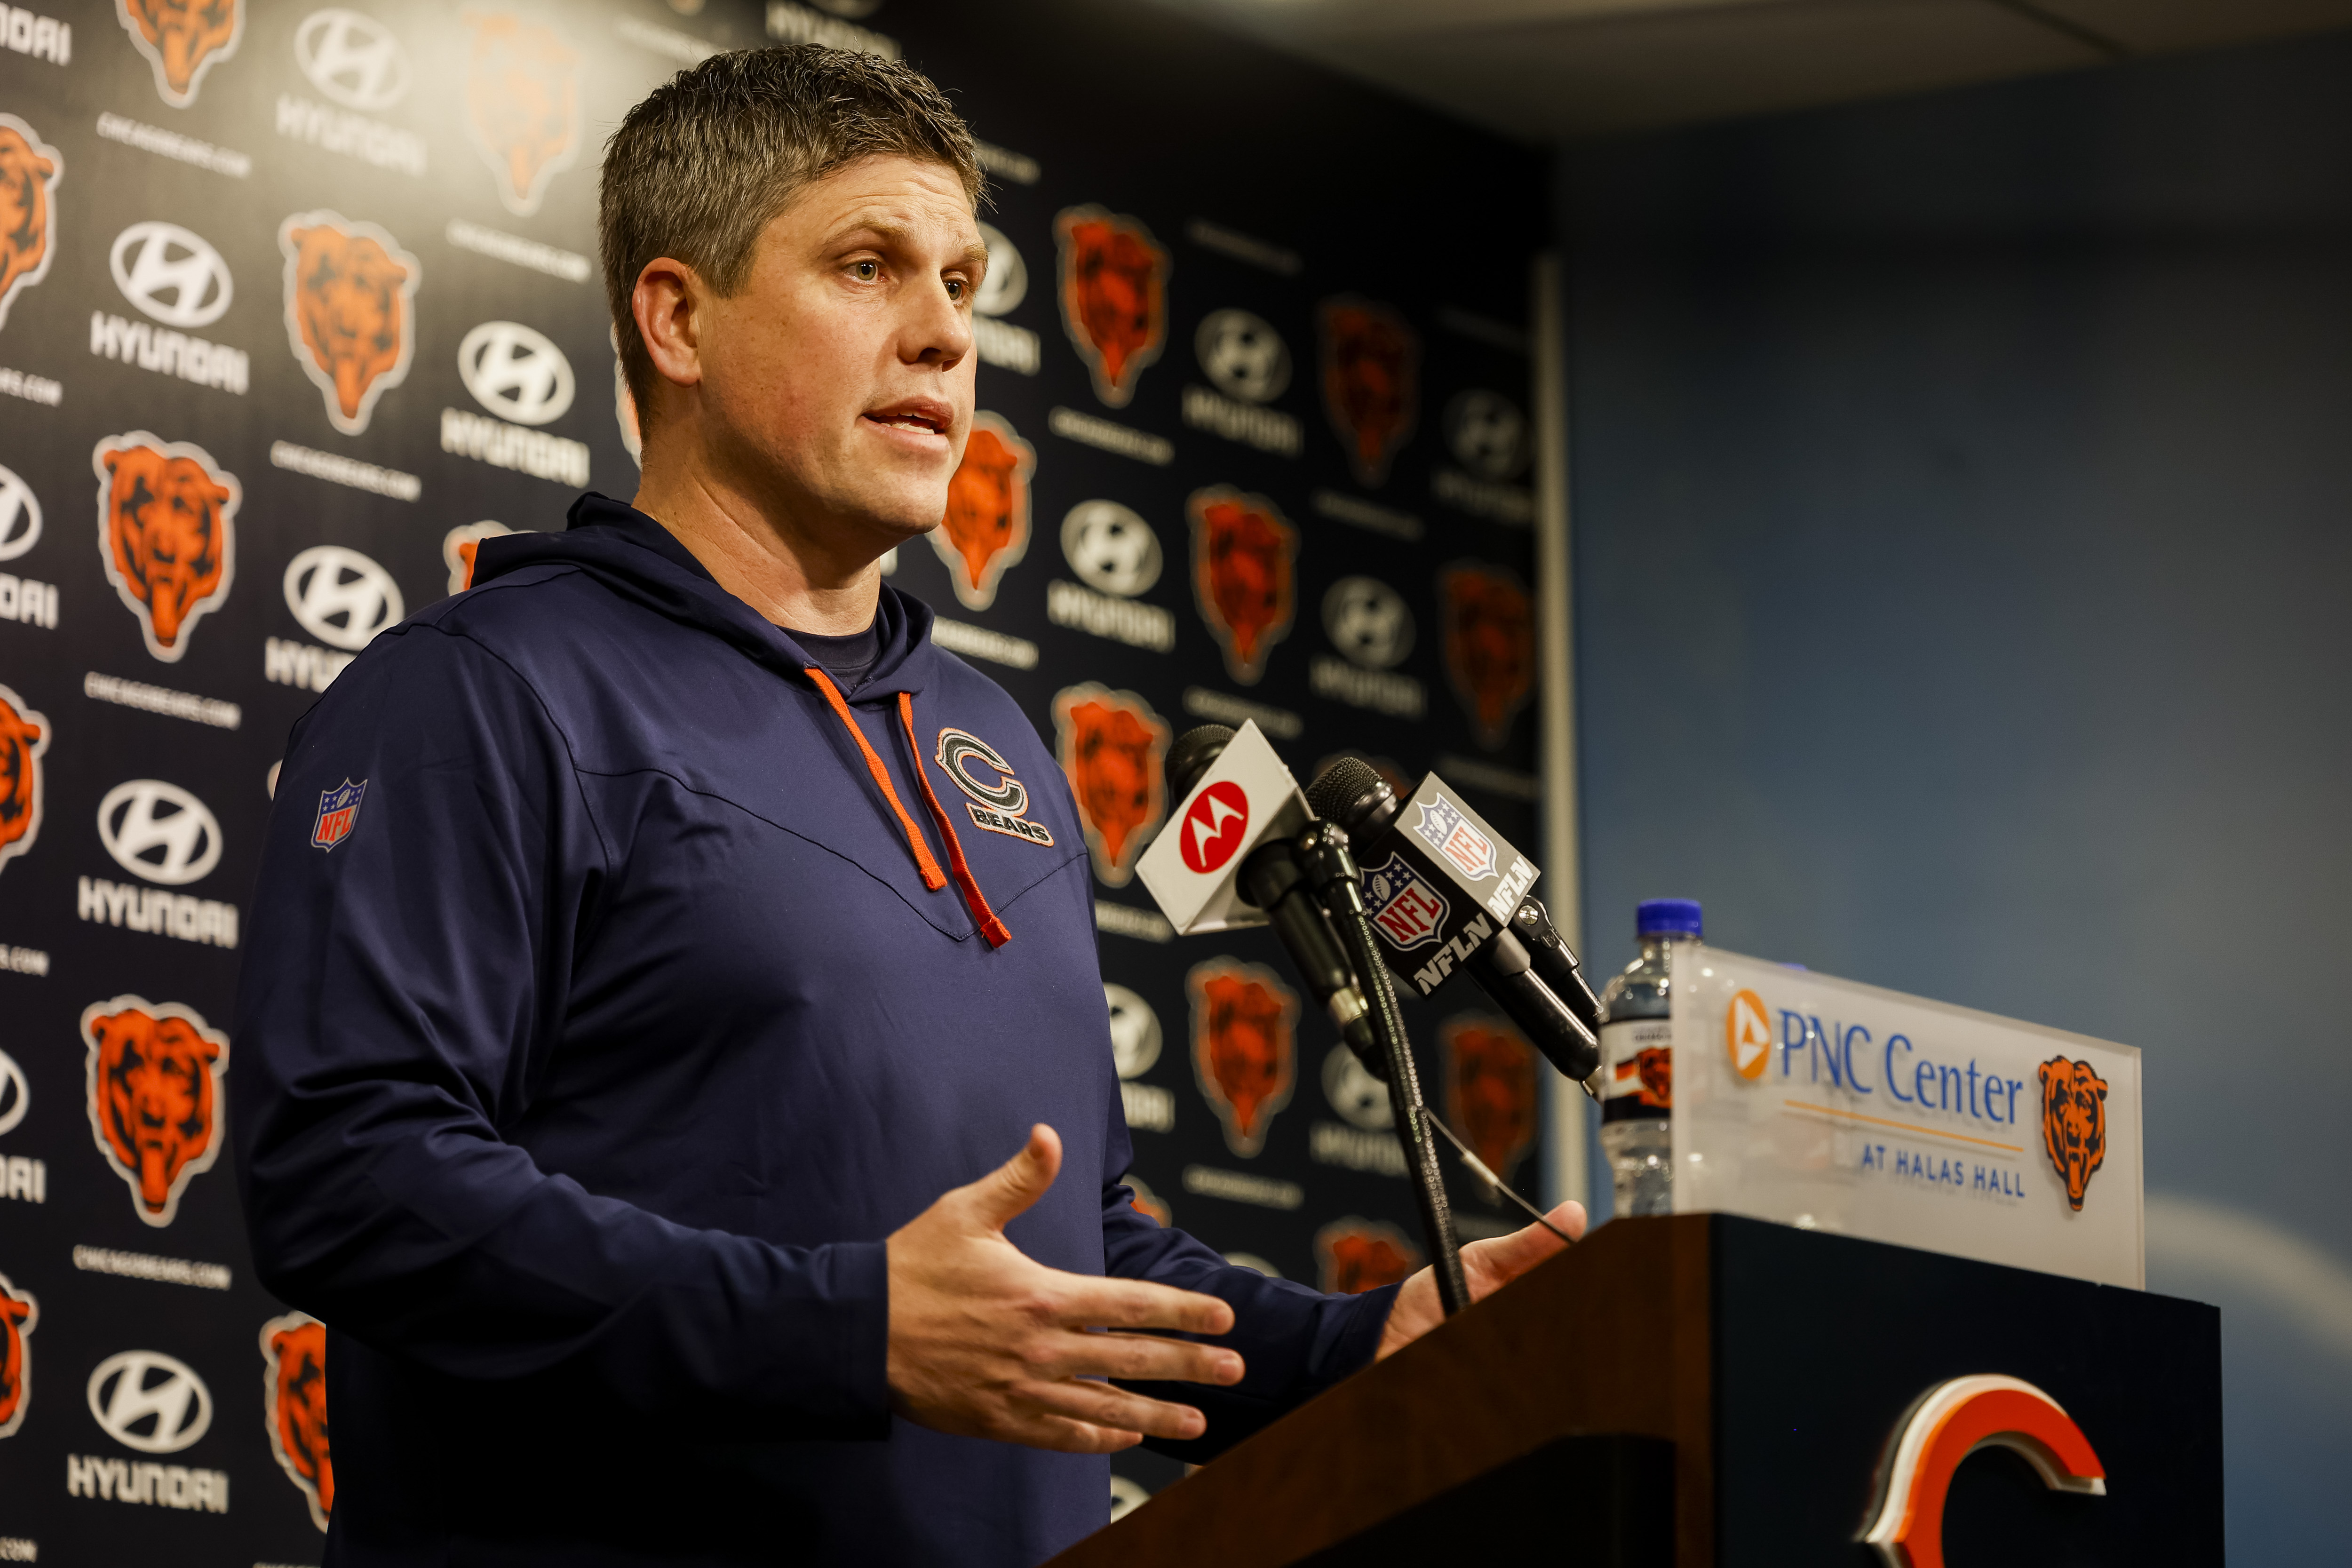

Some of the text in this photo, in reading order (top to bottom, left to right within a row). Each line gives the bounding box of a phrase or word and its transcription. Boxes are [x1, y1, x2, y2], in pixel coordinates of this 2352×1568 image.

[90, 310, 249, 394] HYUNDAI
[317, 808, 351, 842] NFL
[969, 805, 1049, 842] BEARS
[1445, 826, 1488, 872] NFL
[78, 876, 238, 949] HYUNDAI
[1377, 887, 1442, 943] NFL
[1487, 855, 1534, 922] NFLN
[1413, 912, 1493, 996] NFLN
[1778, 1008, 2024, 1125] PNC Center
[1861, 1143, 2025, 1198] AT HALAS HALL
[67, 1454, 229, 1514] HYUNDAI
